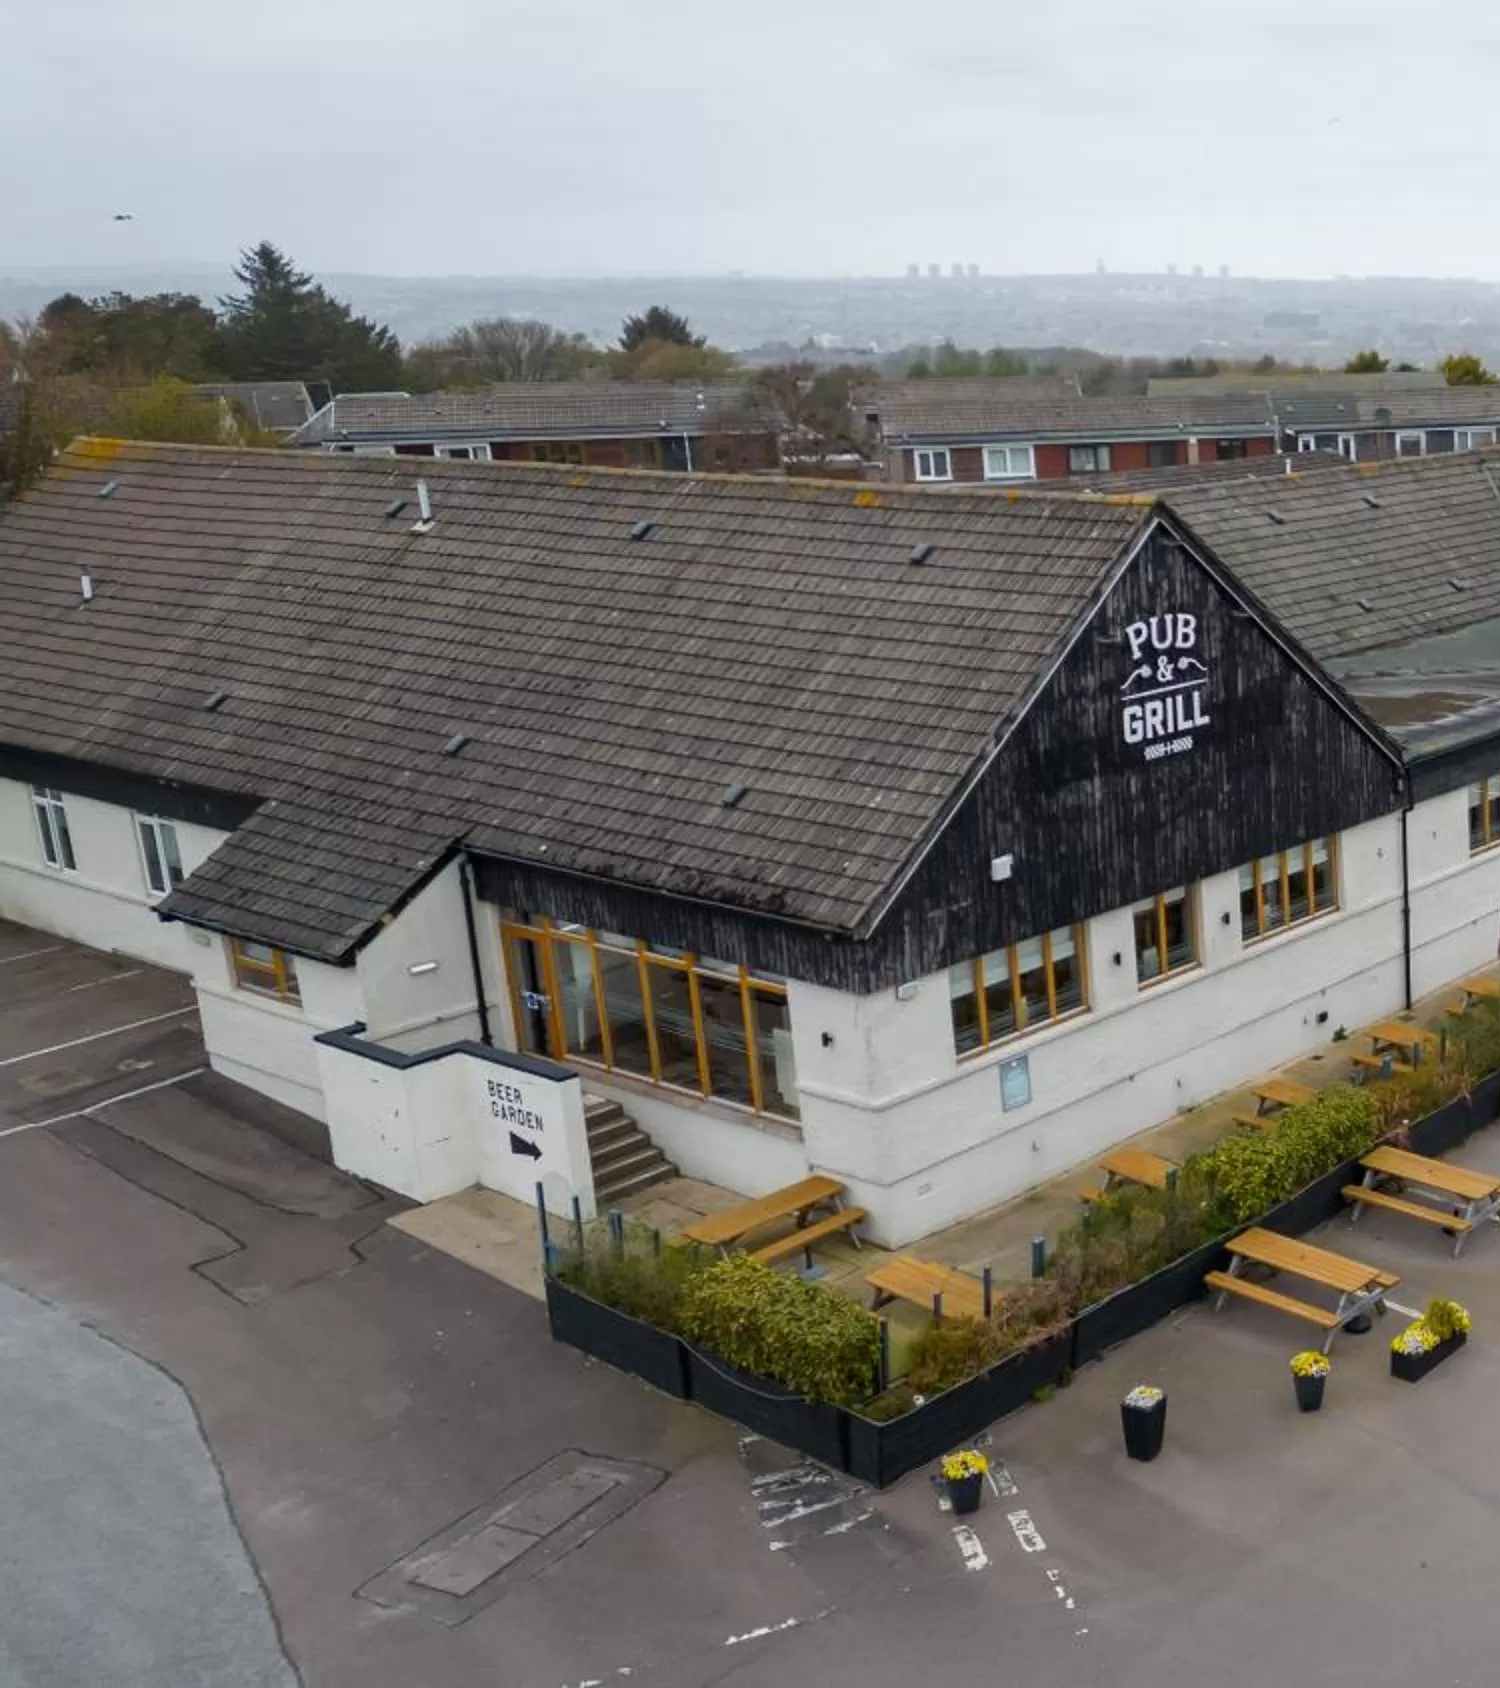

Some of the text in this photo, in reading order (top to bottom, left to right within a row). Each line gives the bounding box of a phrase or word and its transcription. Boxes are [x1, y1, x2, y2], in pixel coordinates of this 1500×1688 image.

[1125, 613, 1197, 660] PUB
[1157, 655, 1175, 682] &
[1123, 690, 1211, 744] GRILL
[487, 1080, 523, 1105] BEER
[491, 1100, 545, 1132] GARDEN
